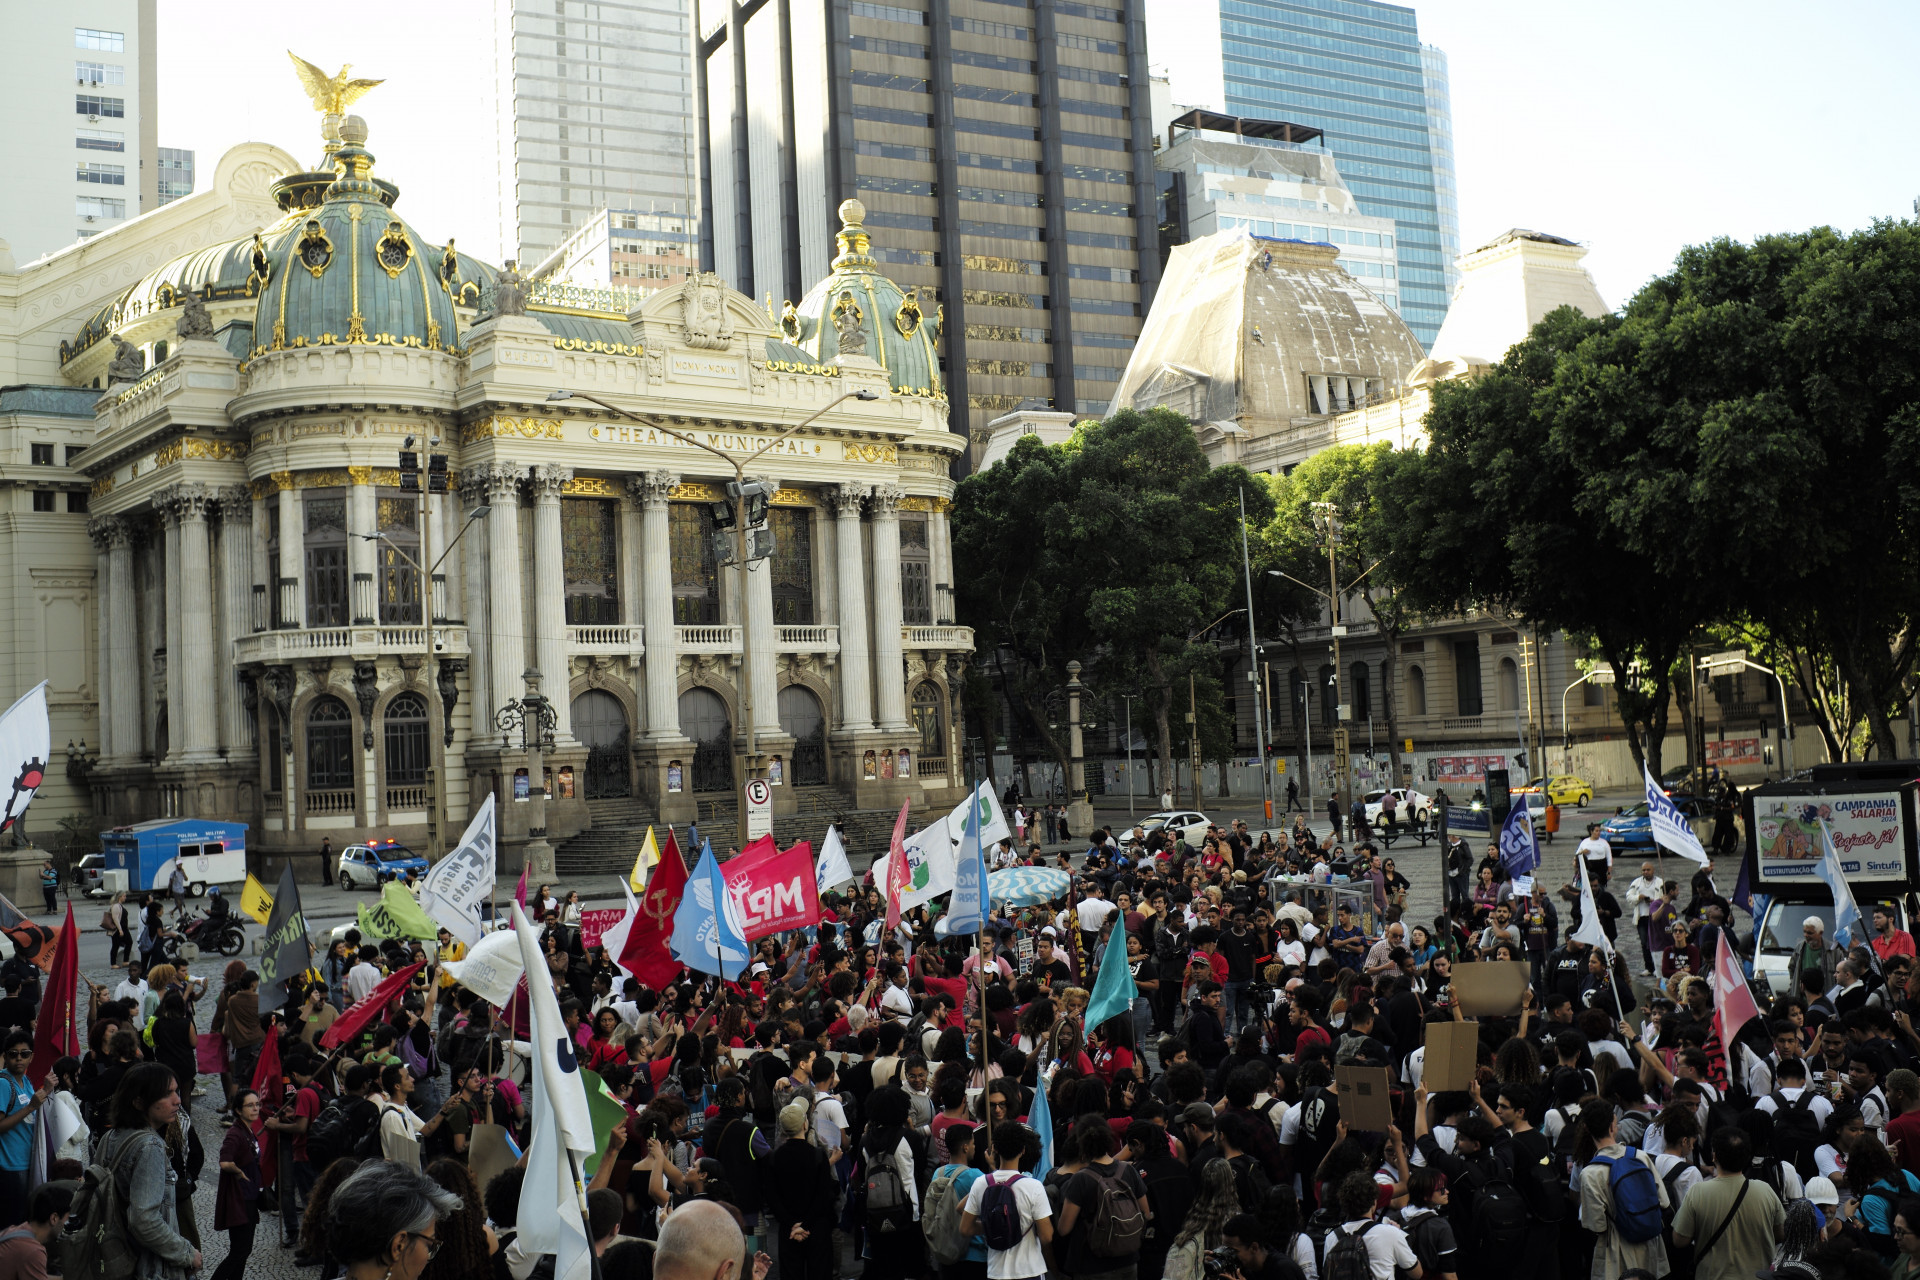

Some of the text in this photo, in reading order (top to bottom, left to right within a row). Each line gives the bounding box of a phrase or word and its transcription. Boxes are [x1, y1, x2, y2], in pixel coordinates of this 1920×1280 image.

[504, 351, 549, 364] MUSICA
[675, 360, 737, 375] MCMVI-MCMIX
[605, 426, 810, 455] THEATRO MUNICIPAL
[753, 784, 763, 799] E
[1835, 798, 1897, 812] CAMPANHA
[1880, 815, 1897, 823] 2024
[1874, 826, 1899, 849] já!
[1764, 865, 1810, 876] REESTRUTURAÇÃO
[1848, 863, 1859, 871] TAE
